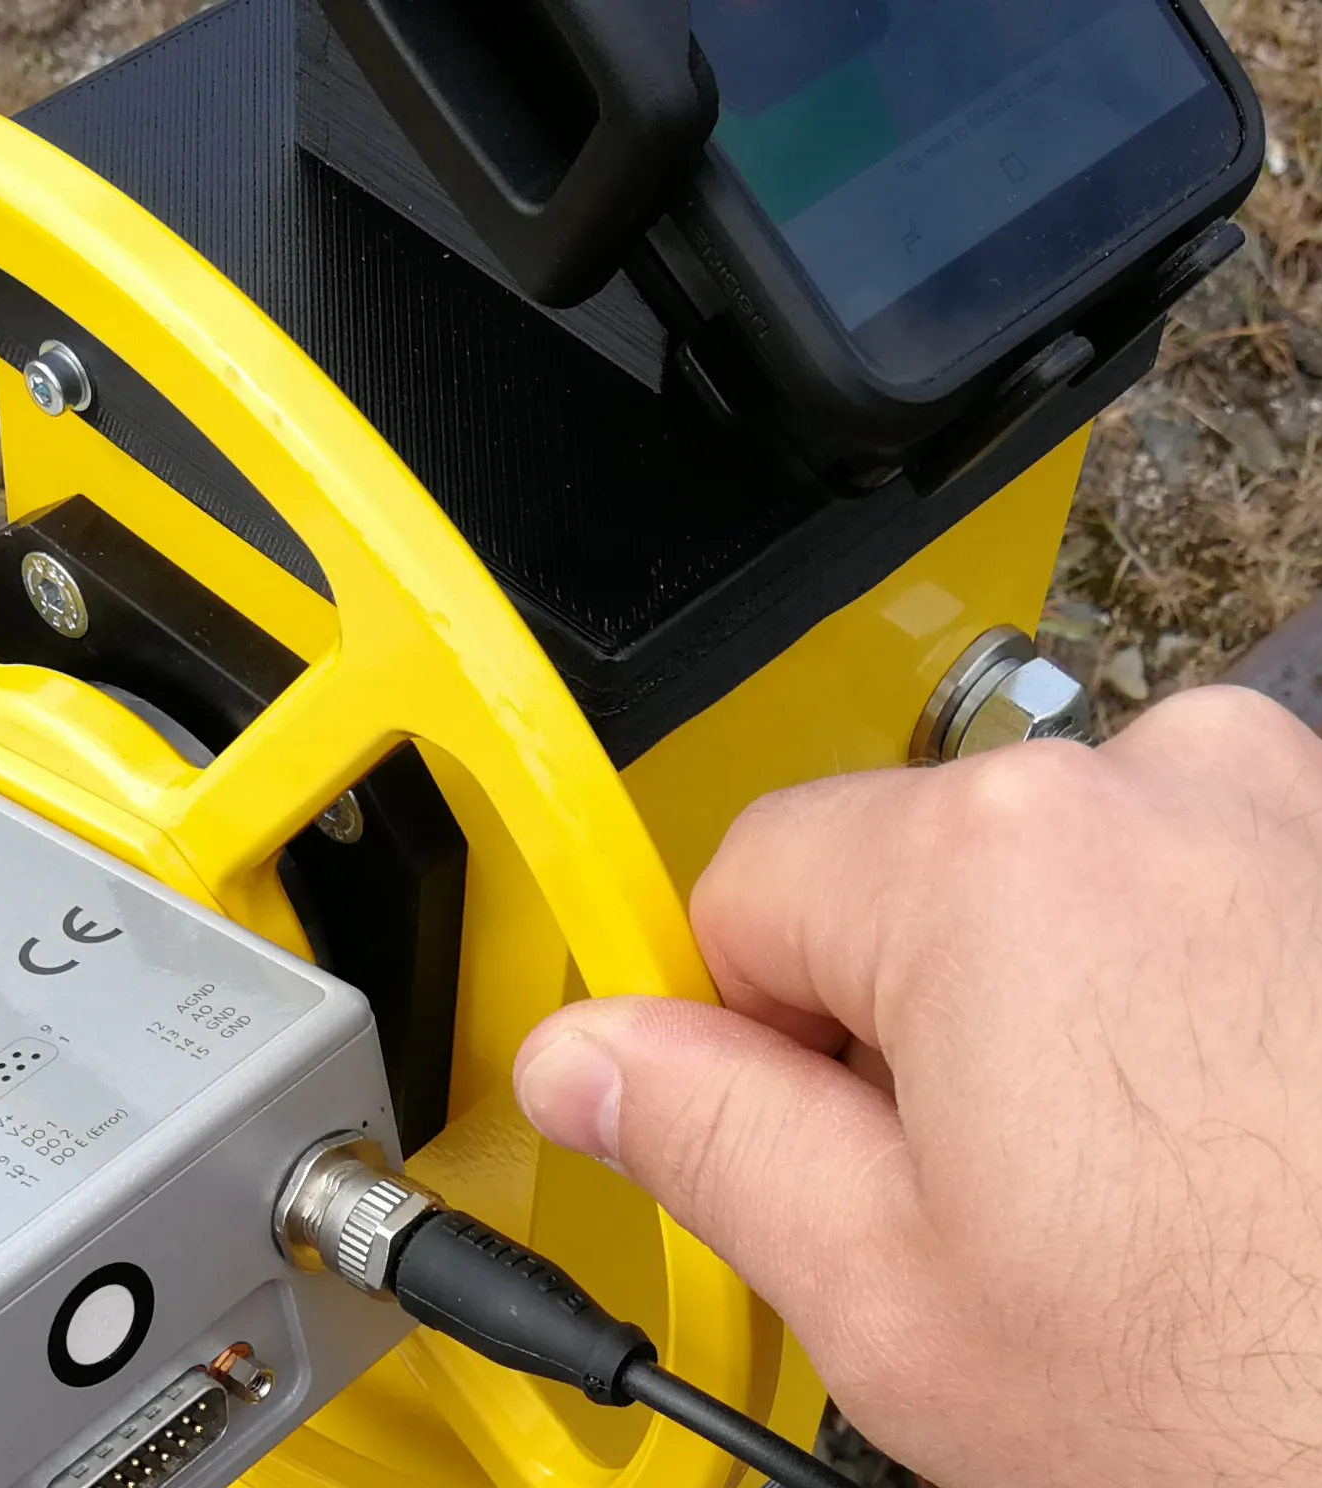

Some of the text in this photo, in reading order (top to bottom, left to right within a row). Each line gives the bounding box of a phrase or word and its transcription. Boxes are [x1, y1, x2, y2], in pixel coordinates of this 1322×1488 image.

[12, 905, 123, 979] CE
[144, 982, 216, 1035] 12 AGND
[159, 1004, 214, 1043] 13 AO
[174, 1005, 237, 1051] 14 GND
[189, 1014, 252, 1060] 15 GND
[4, 1122, 29, 1137] V+
[19, 1107, 129, 1188] 11 DO E (Error)
[20, 1128, 47, 1147] DO
[45, 1120, 58, 1128] 1
[34, 1137, 62, 1156] DO
[58, 1128, 74, 1139] 2
